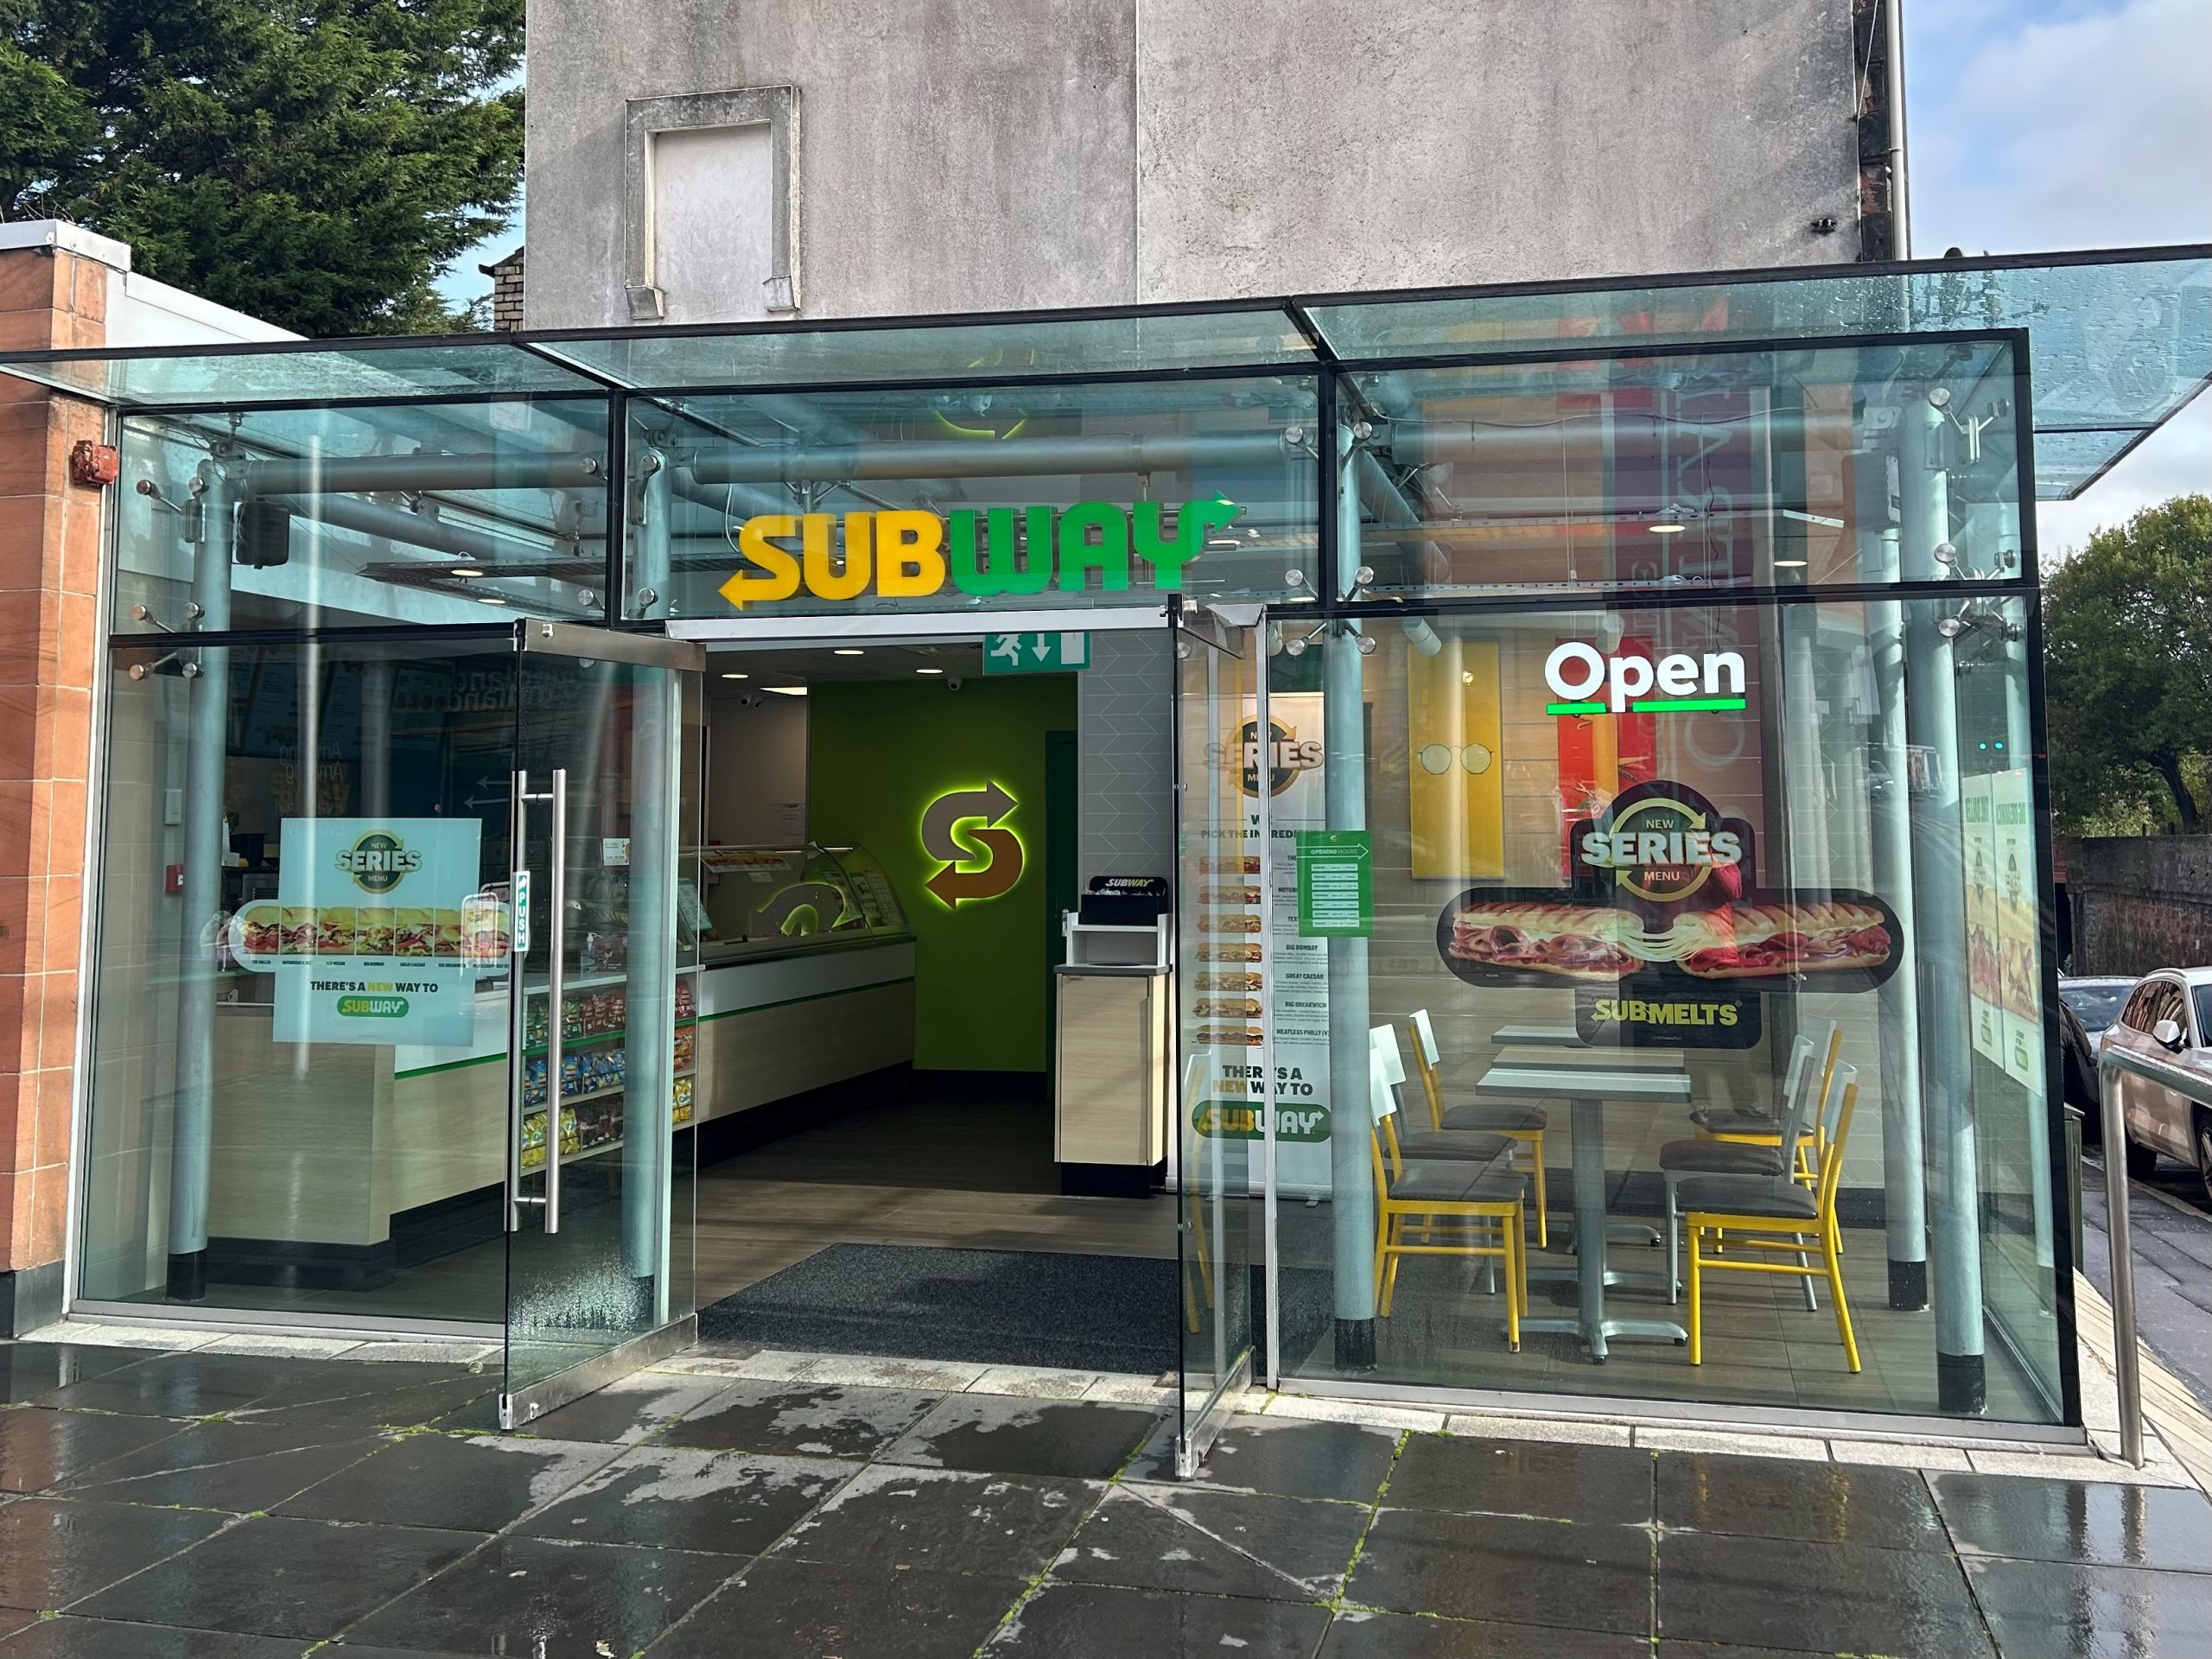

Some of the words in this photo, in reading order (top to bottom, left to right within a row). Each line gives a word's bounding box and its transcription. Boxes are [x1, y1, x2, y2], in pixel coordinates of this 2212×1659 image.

[719, 490, 1245, 613] SUBWAY
[1544, 641, 1745, 714] Open
[1645, 819, 1675, 830] NEW
[1228, 830, 1248, 839] THE
[1580, 831, 1743, 868] SERIES
[334, 849, 423, 873] SERIES
[1105, 878, 1154, 887] SUBWAY
[1643, 871, 1681, 881] MENU
[310, 981, 355, 991] THERE'S
[357, 982, 365, 991] A
[367, 982, 394, 992] NEW
[396, 982, 421, 992] WAY
[423, 983, 439, 993] TO
[341, 999, 405, 1014] SUBWAY
[1591, 999, 1739, 1027] SUBMELTS
[1290, 1067, 1302, 1080] A
[1290, 1083, 1313, 1096] TO
